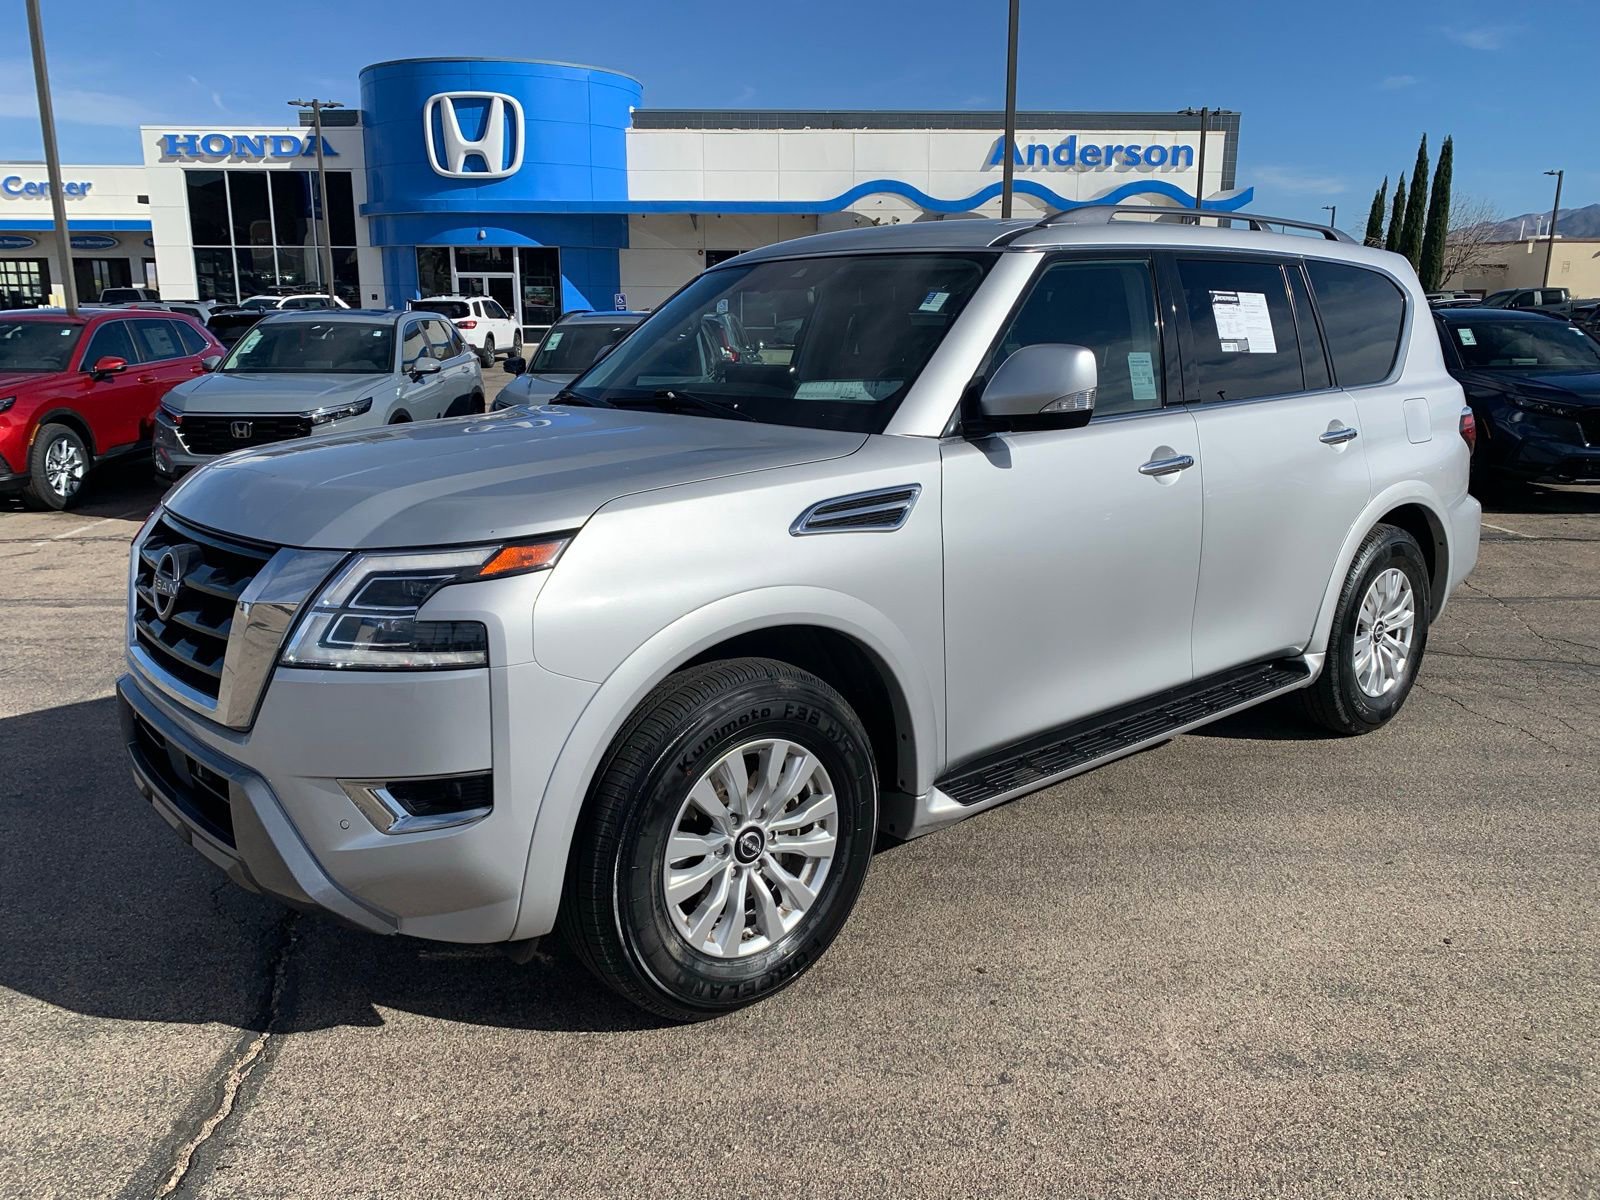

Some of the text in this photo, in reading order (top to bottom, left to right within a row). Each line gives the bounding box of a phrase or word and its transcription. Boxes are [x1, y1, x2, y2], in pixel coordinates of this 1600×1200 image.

[163, 133, 339, 157] HONDA
[990, 135, 1194, 167] Anderson
[2, 175, 92, 196] Cener
[677, 706, 771, 774] Kunimoto
